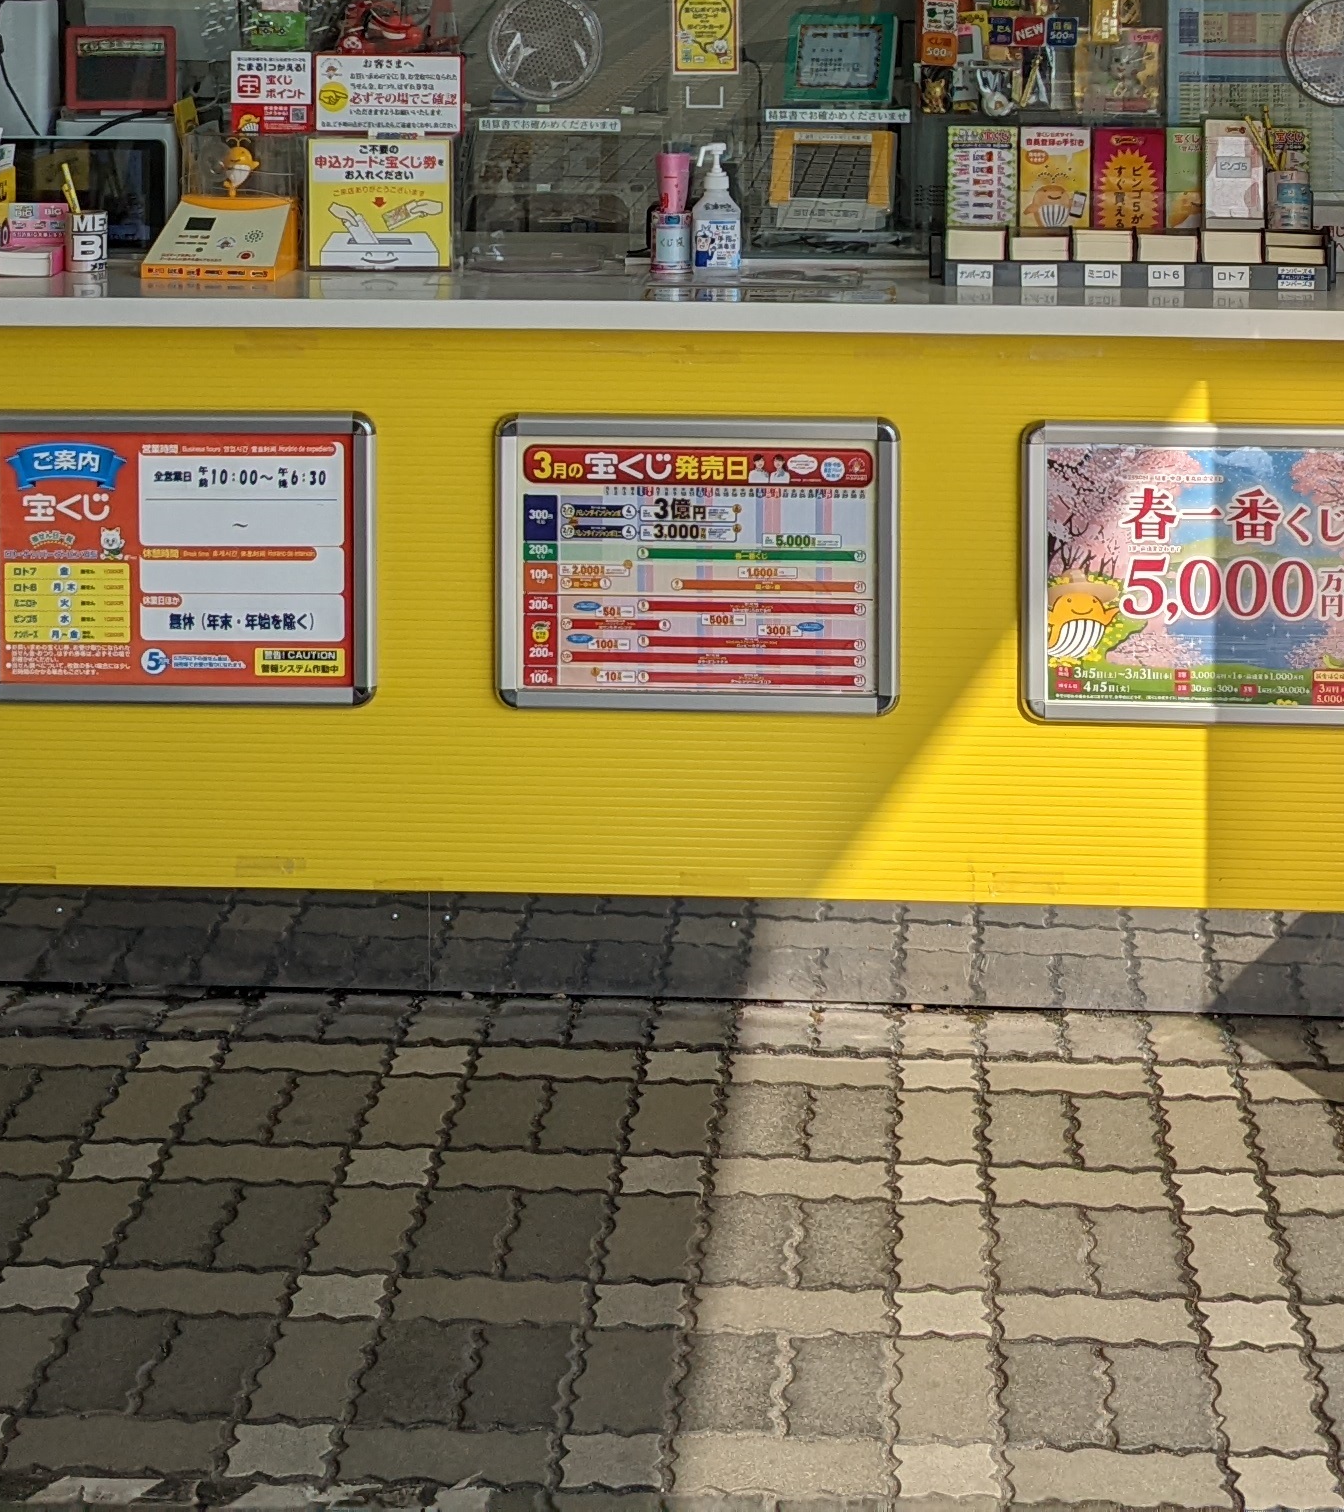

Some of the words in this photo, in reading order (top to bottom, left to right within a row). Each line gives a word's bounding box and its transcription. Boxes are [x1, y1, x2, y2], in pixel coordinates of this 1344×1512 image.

[1015, 23, 1044, 42] NEW
[362, 58, 416, 70] お客さまへ
[265, 74, 294, 86] 宝くじ
[265, 88, 306, 100] ポイント
[349, 92, 458, 106] 必ずその場でご確認
[766, 109, 910, 123] 精算書でお確かめくださいませ
[358, 144, 400, 155] ご不要の
[314, 155, 445, 170] 申込カードと宝くじ券を
[1219, 161, 1248, 171] ビンゴ5
[344, 170, 415, 181] お入れください
[1130, 165, 1144, 225] ビンゴ5が
[1087, 269, 1120, 281] ミニロト
[1151, 268, 1182, 281] ロト6
[1216, 269, 1246, 282] ロト7
[32, 449, 102, 474] ご案内
[533, 449, 750, 482] 3月の宝くじ発売日
[153, 470, 193, 483] 全営業日
[22, 492, 111, 523] 宝くじ
[653, 498, 707, 521] 3億円
[287, 650, 337, 661] CAUTION
[260, 663, 339, 675] 警報システム作動中
